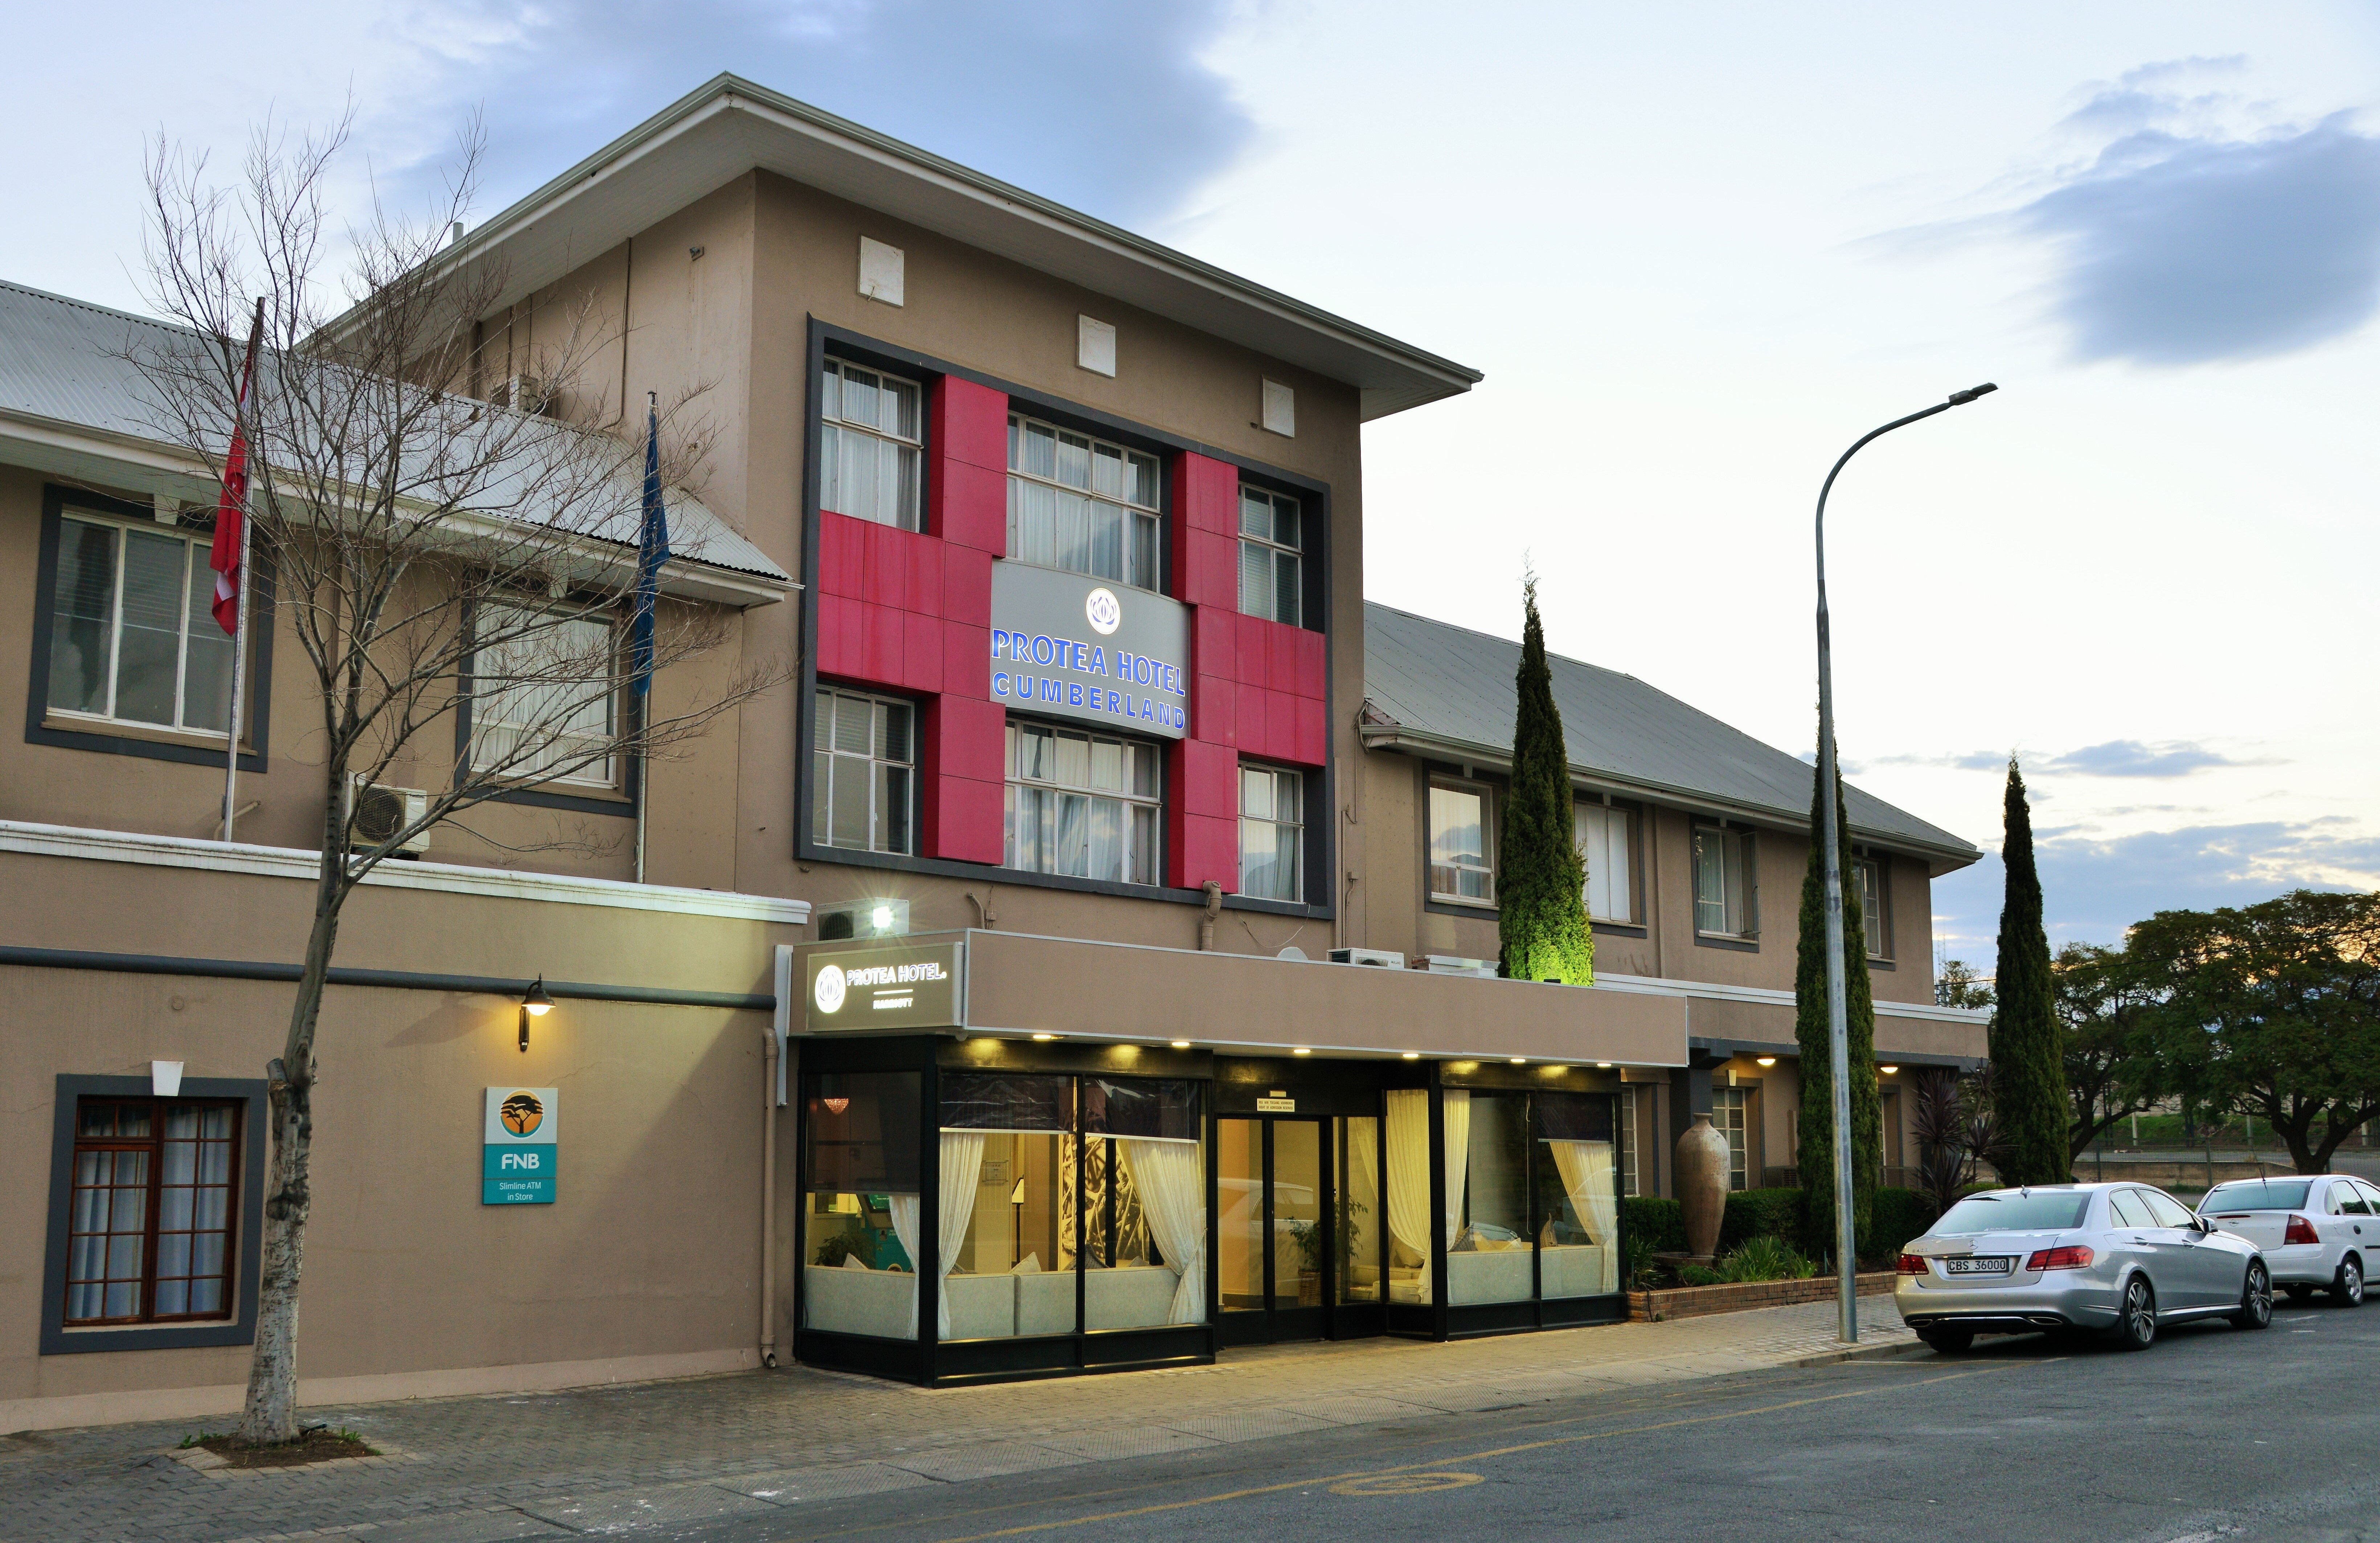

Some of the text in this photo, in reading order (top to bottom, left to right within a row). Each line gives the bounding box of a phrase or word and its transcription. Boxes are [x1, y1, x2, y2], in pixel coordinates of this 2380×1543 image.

[992, 628, 1185, 697] PROTEA HOTEL
[992, 672, 1185, 730] CUMBERLAND
[847, 966, 896, 986] PROTEA
[502, 1153, 540, 1169] FNB
[1949, 1260, 2006, 1271] CBS 36000
